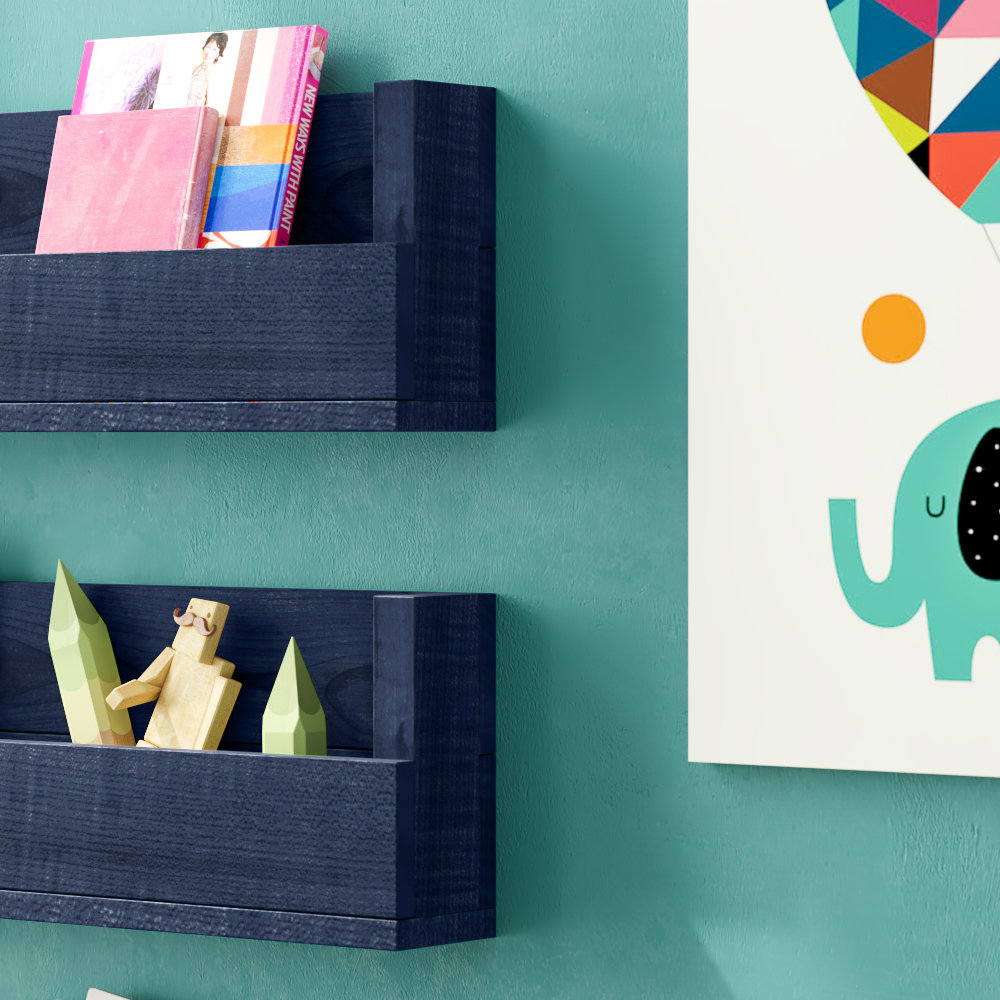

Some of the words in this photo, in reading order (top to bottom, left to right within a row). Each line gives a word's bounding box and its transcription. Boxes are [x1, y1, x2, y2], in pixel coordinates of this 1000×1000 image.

[303, 83, 317, 117] NEW
[295, 116, 311, 154] WAYS
[287, 154, 303, 191] WITH
[280, 191, 296, 234] PAINT
